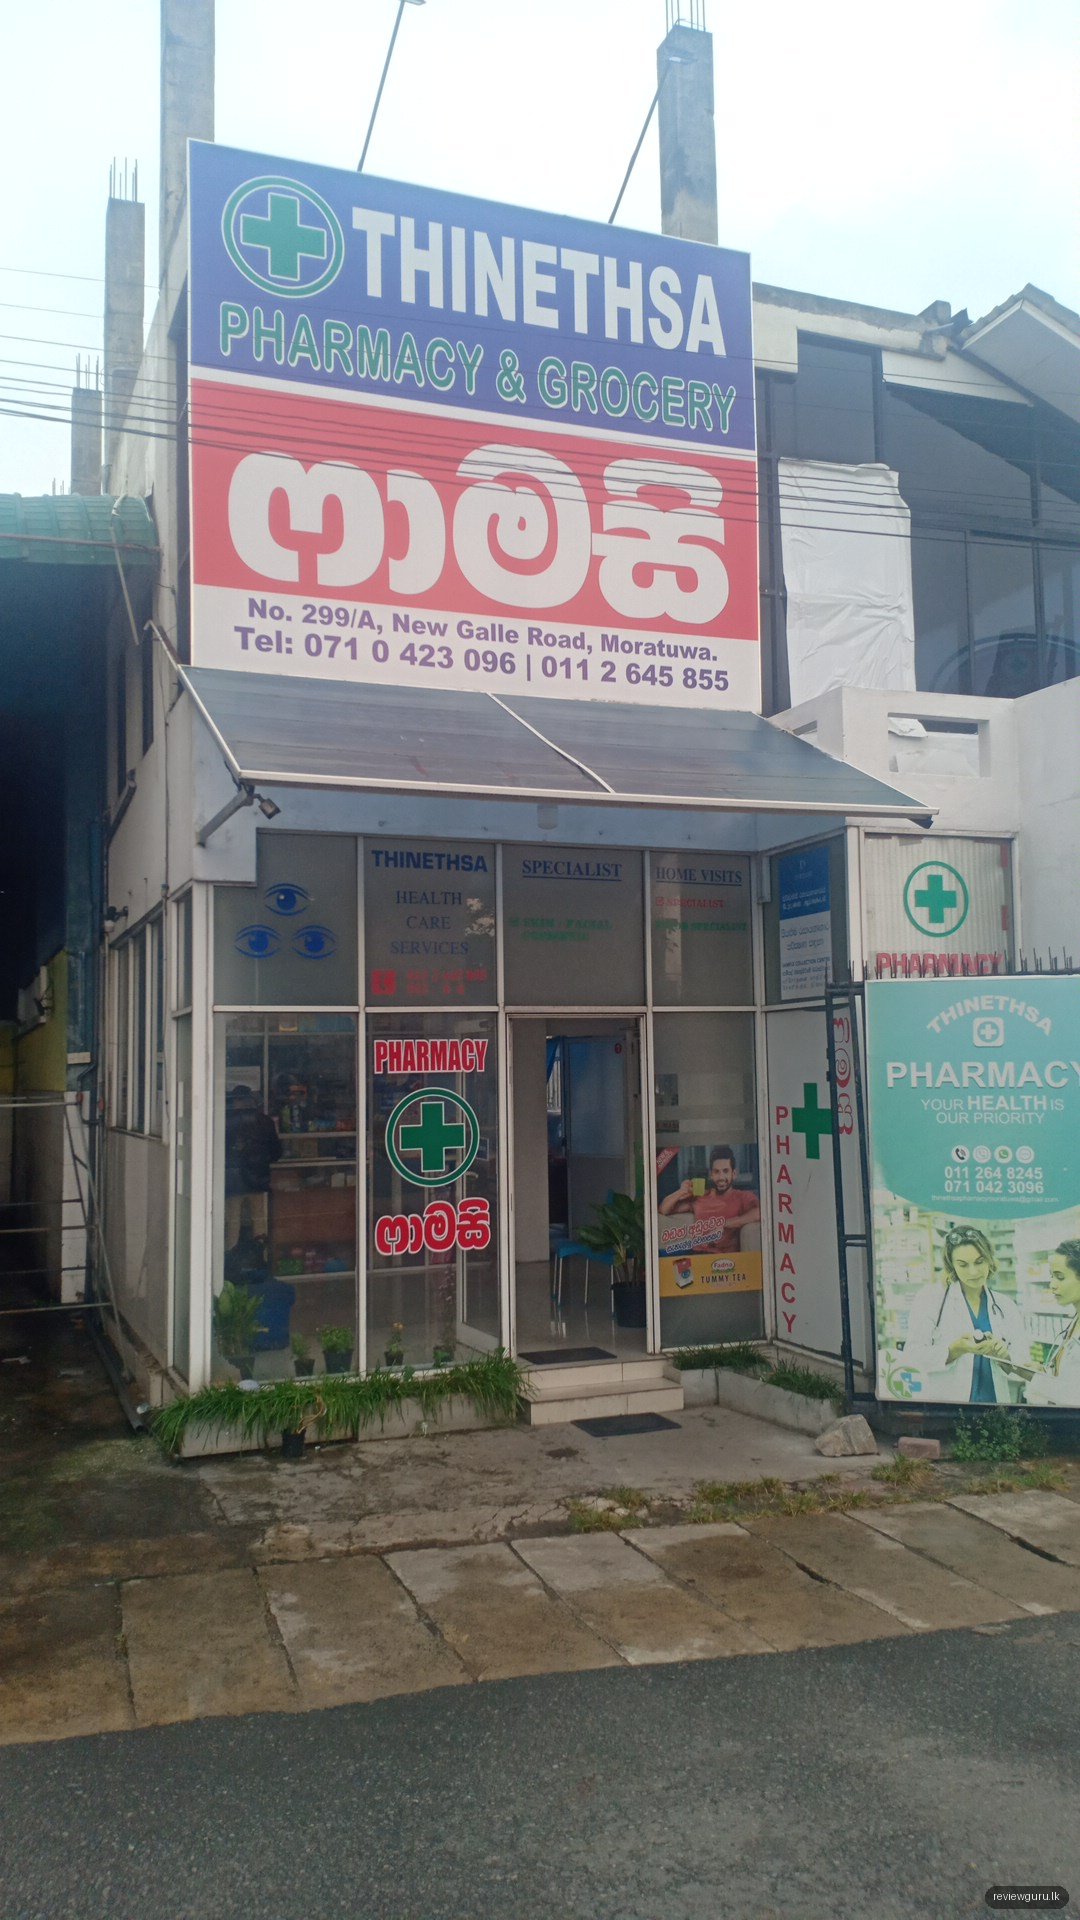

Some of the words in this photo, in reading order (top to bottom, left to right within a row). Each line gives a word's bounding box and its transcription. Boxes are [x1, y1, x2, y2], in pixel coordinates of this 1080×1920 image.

[352, 207, 727, 358] THINETHSA
[219, 301, 483, 396] PHARMACY
[496, 349, 527, 403] &
[537, 355, 736, 434] GROCERY
[228, 444, 729, 624] ෆාමසි
[249, 598, 292, 621] No.
[302, 603, 383, 635] 299/A,
[392, 613, 448, 637] New
[457, 620, 519, 644] Galle
[527, 626, 593, 655] Road,
[601, 634, 718, 661] Moratuwa.
[234, 626, 293, 655] Tel:
[304, 633, 358, 660] 071
[372, 639, 389, 663] 0
[399, 643, 454, 669] 423
[464, 648, 516, 674] 096
[541, 655, 588, 681] 011
[601, 660, 617, 683] 2
[626, 663, 674, 687] 645
[682, 667, 729, 691] 855
[371, 850, 488, 872] THINETHSA
[522, 859, 622, 878] SPECIALIST
[656, 867, 697, 881] HOME
[700, 869, 742, 883] VISITS
[396, 891, 462, 905] HEALTH
[406, 916, 450, 930] CARE
[391, 941, 469, 955] SERVICES
[926, 995, 1053, 1036] THINETHSA
[374, 1039, 488, 1074] PHARMACY
[921, 1099, 964, 1111] YOUR
[967, 1095, 1047, 1111] HEALTH
[1051, 1099, 1064, 1111] IS
[936, 1112, 970, 1124] OUR
[973, 1112, 1045, 1124] PRIORITY
[944, 1167, 969, 1179] 011
[975, 1167, 1002, 1179] 264
[1007, 1167, 1043, 1179] 8245
[944, 1181, 970, 1193] 071
[975, 1181, 1003, 1193] 042
[1008, 1181, 1044, 1193] 3096
[775, 1105, 797, 1334] PHARMACY
[701, 1274, 729, 1283] TUMMY
[732, 1273, 746, 1282] TEA
